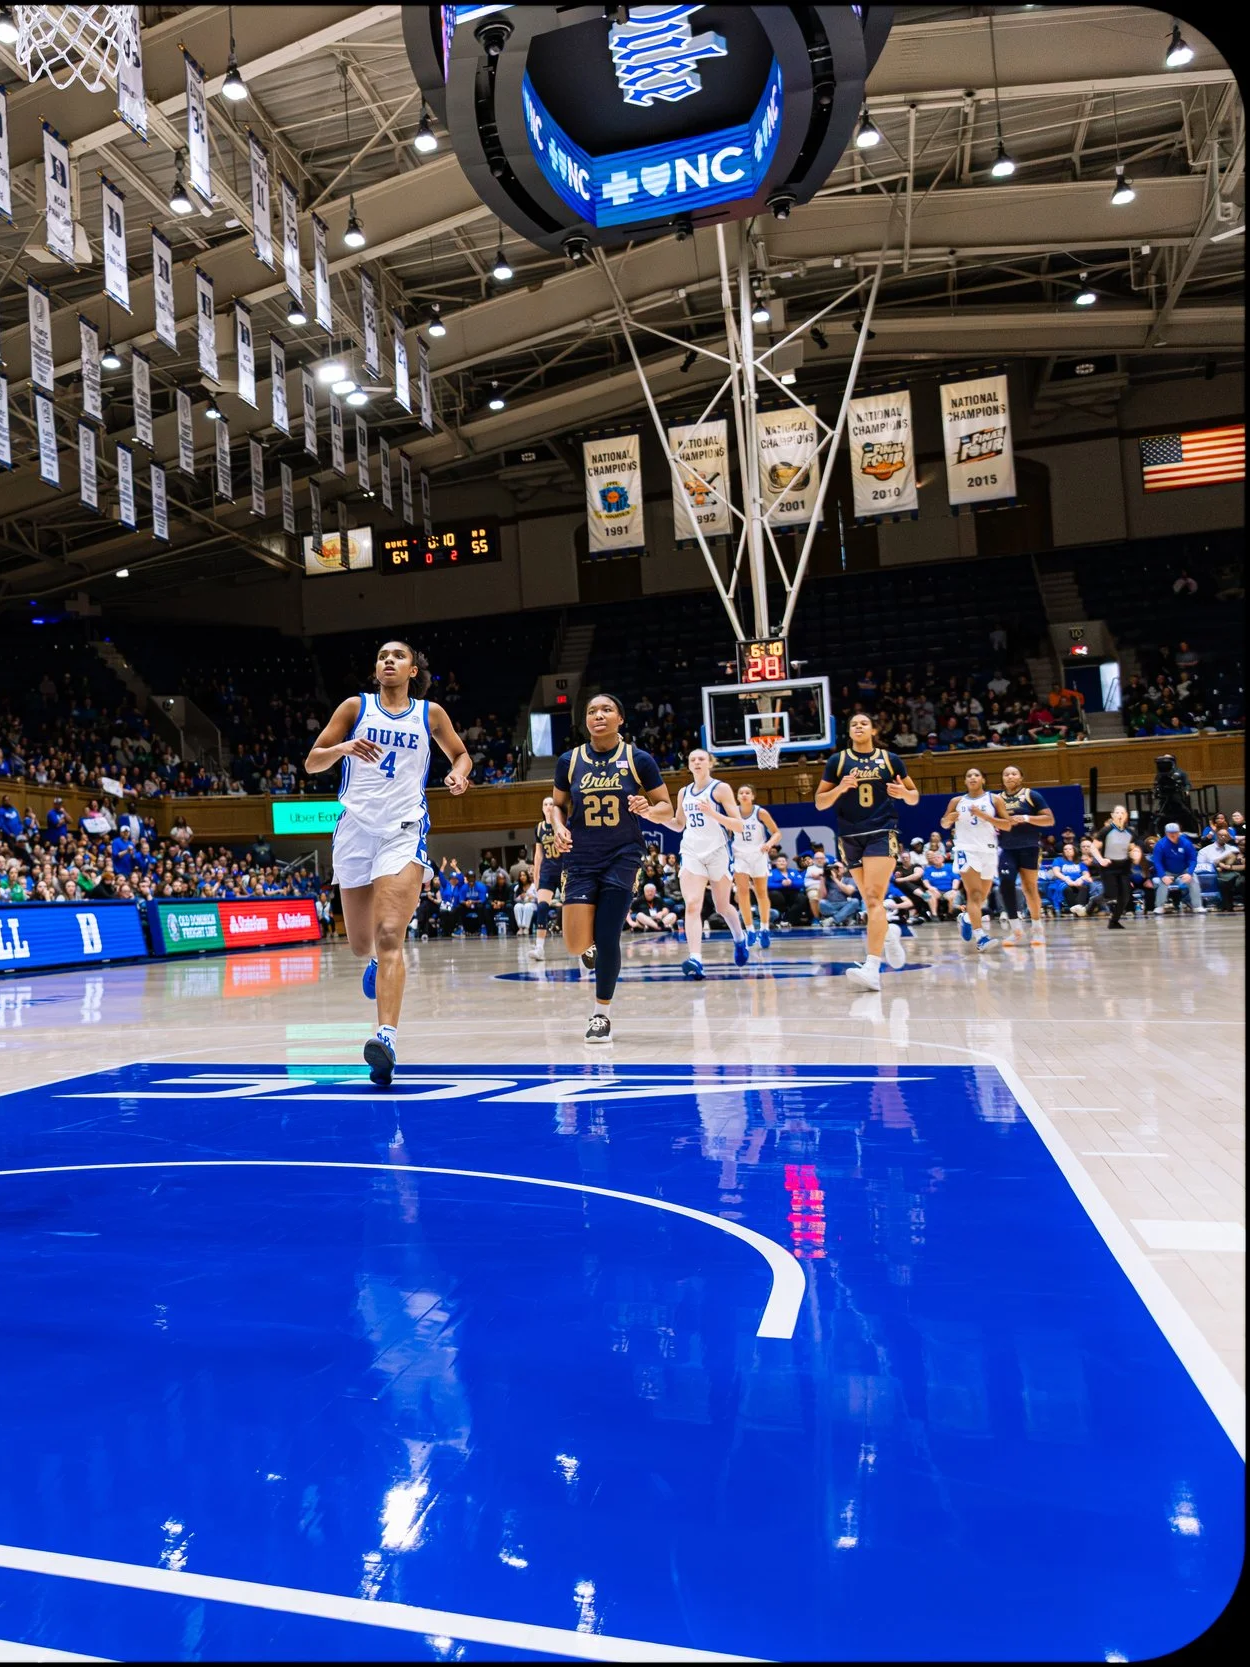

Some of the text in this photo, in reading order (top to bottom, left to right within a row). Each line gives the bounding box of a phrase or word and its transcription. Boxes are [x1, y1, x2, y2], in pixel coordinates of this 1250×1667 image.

[609, 5, 727, 107] uke
[675, 146, 746, 193] NC
[567, 156, 590, 201] NC
[951, 391, 999, 409] NATIONAL
[856, 406, 902, 423] NATIONAL
[947, 403, 1006, 423] CHAMPIONS
[852, 418, 909, 437] CHAMPIONS
[972, 427, 1006, 444] FINAL
[591, 450, 633, 464] NATIONAL
[678, 446, 725, 462] HAMPIONS
[959, 438, 1003, 460] FOUR
[587, 461, 638, 477] CHAMPIONS
[967, 474, 998, 487] 2015
[872, 487, 901, 500] 2010
[779, 500, 806, 512] 2001
[696, 512, 716, 524] 992
[604, 525, 629, 537] 1991
[384, 539, 408, 549] DUKE
[392, 539, 489, 564] 64 0 2 55
[750, 642, 783, 657] 6:10
[748, 656, 780, 681] 28
[367, 727, 419, 750] DUKE
[379, 751, 397, 779] 4
[579, 767, 623, 792] Irish
[858, 783, 874, 808] 8
[290, 812, 316, 823] Uber
[583, 795, 620, 827] 23
[689, 813, 705, 828] 35
[970, 816, 978, 826] 3
[741, 831, 753, 842] 12
[543, 843, 561, 859] 30
[178, 915, 191, 927] OLD
